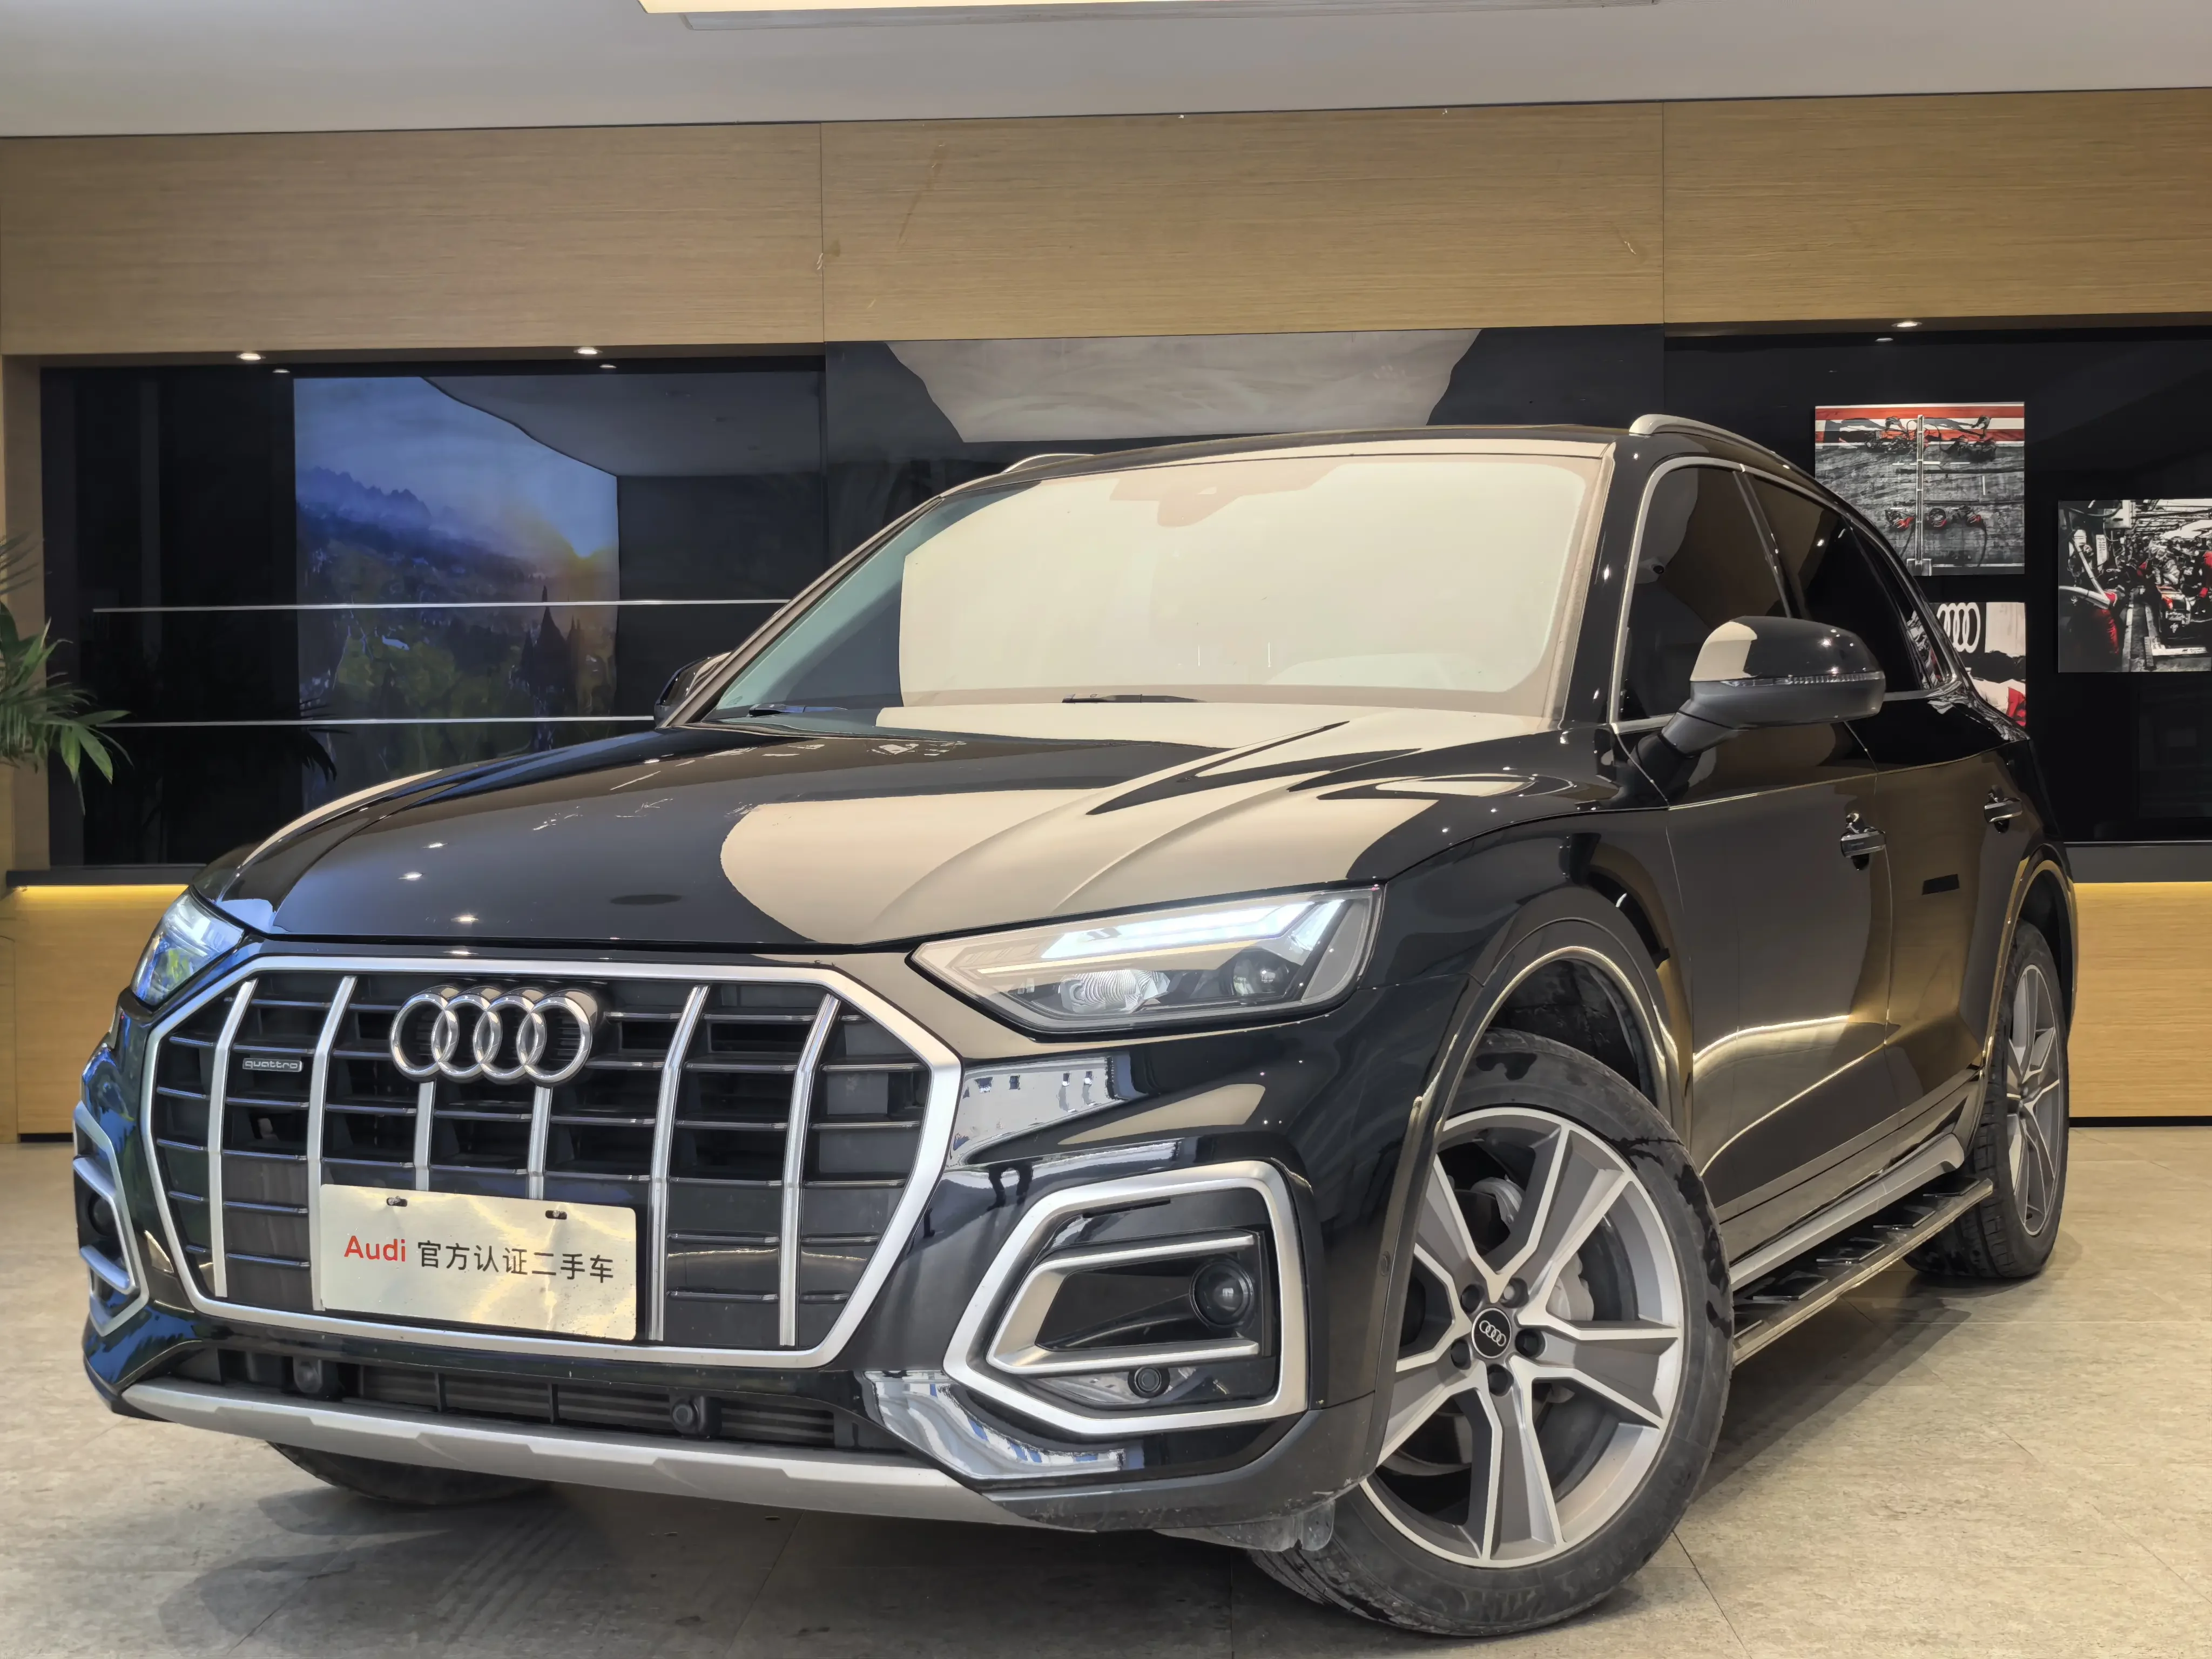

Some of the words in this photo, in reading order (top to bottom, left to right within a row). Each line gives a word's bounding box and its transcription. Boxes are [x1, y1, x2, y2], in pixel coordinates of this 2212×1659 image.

[245, 1060, 298, 1069] quattro
[344, 1236, 406, 1262] Audi
[417, 1240, 613, 1284] 官方认证二手车
